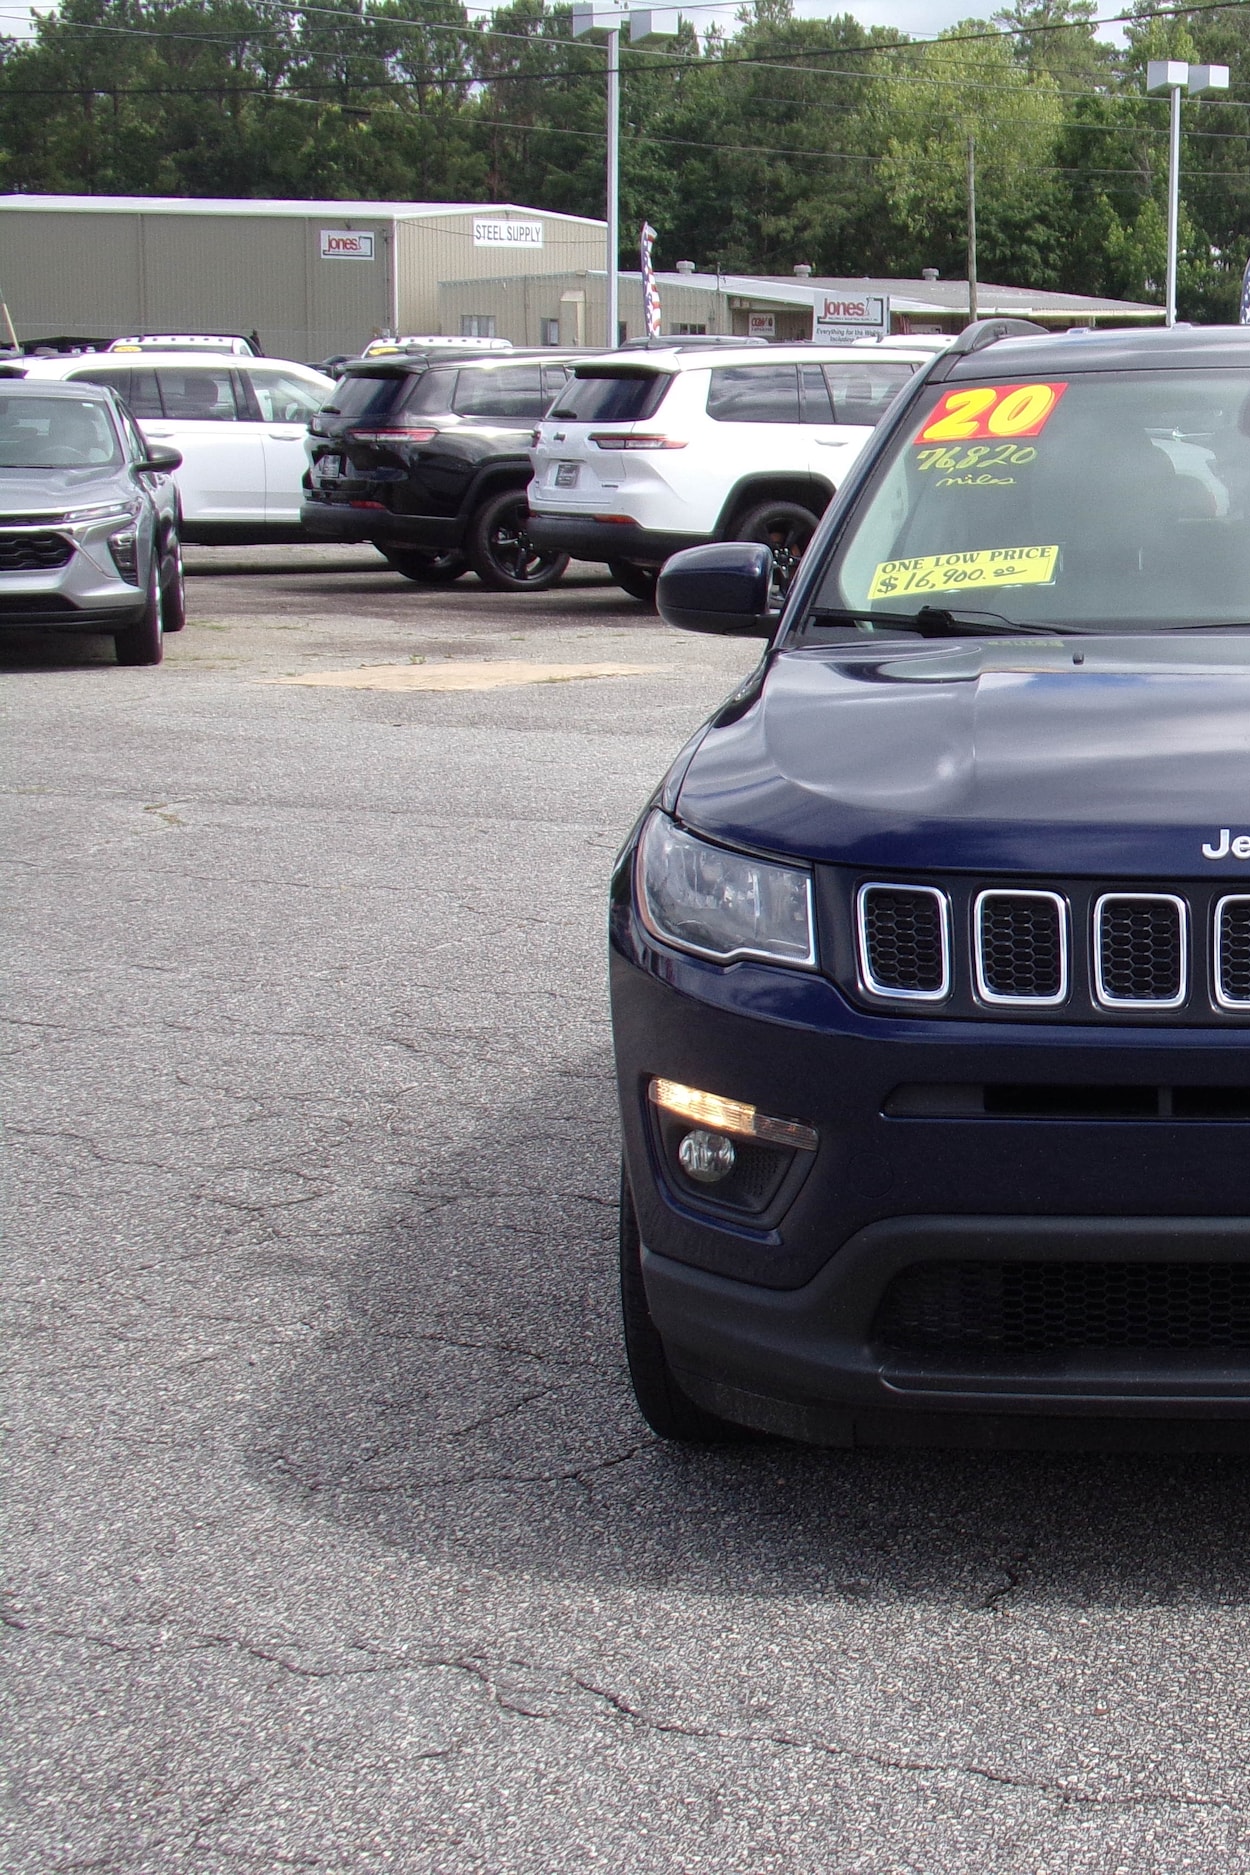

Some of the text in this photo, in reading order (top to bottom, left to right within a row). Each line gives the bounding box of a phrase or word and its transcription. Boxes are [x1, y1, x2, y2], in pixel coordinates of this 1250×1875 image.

[475, 224, 541, 242] STEEL SUPPLY
[923, 384, 1055, 440] 20
[917, 444, 1037, 474] 76,820
[881, 546, 1052, 575] ONE LOW PRICE
